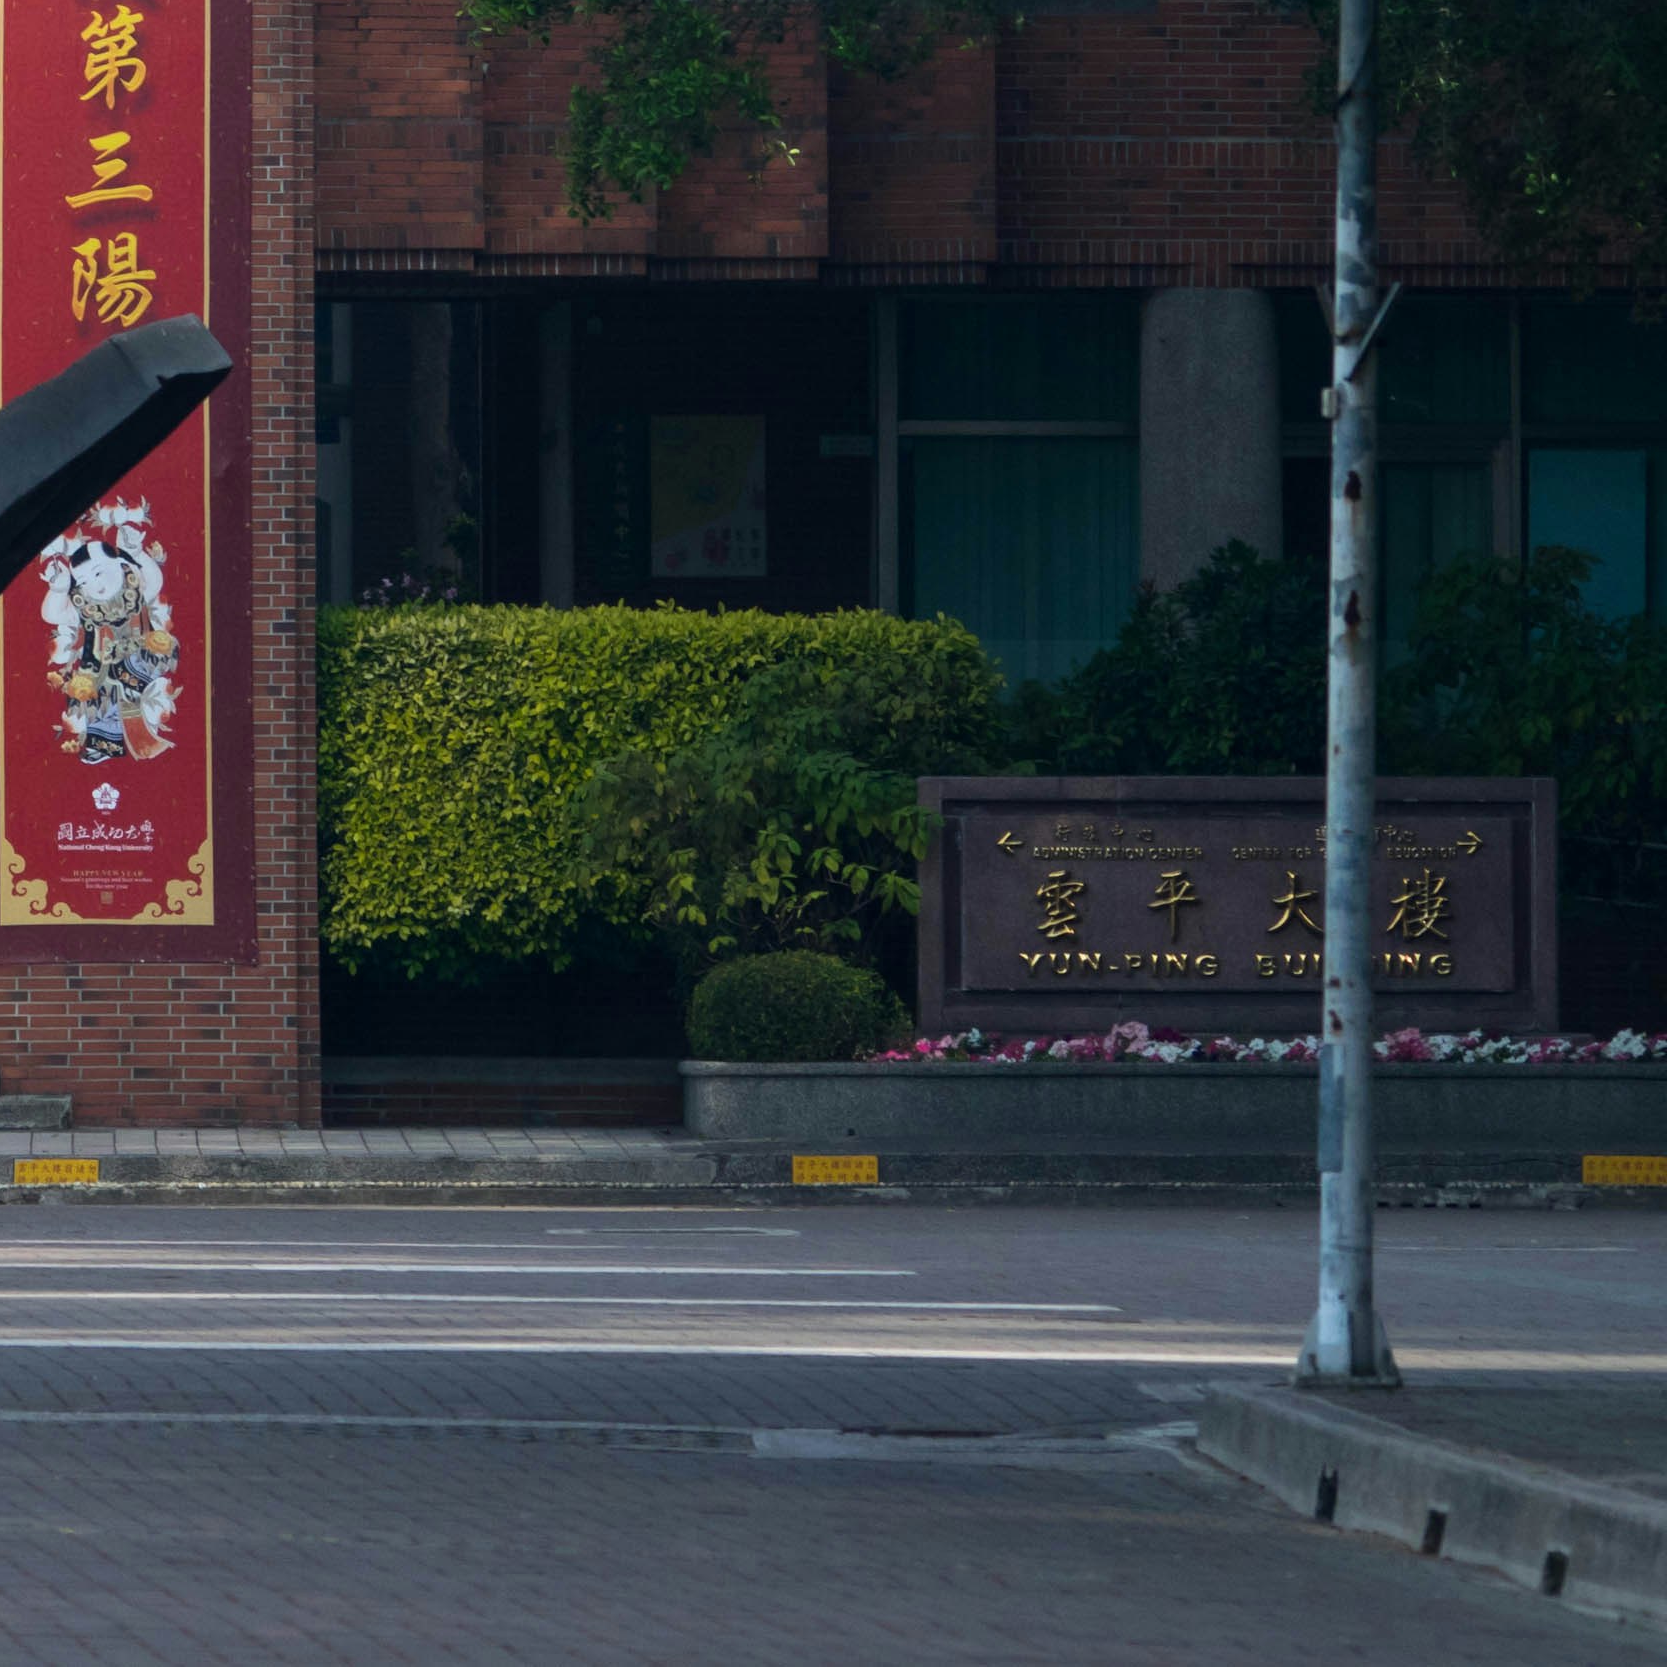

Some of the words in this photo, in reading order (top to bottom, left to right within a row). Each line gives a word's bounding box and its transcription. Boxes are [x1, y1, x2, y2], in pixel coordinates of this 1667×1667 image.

[57, 819, 155, 843] 國立成功大學
[1033, 846, 1144, 859] ADMINISTRATION
[1148, 846, 1203, 859] CENTER
[1232, 847, 1280, 860] CENTER
[1386, 847, 1457, 860] EDUCATION
[1035, 868, 1449, 945] 雲平大樓
[1019, 951, 1220, 977] YUN-PING
[1255, 951, 1454, 977] BUIING
